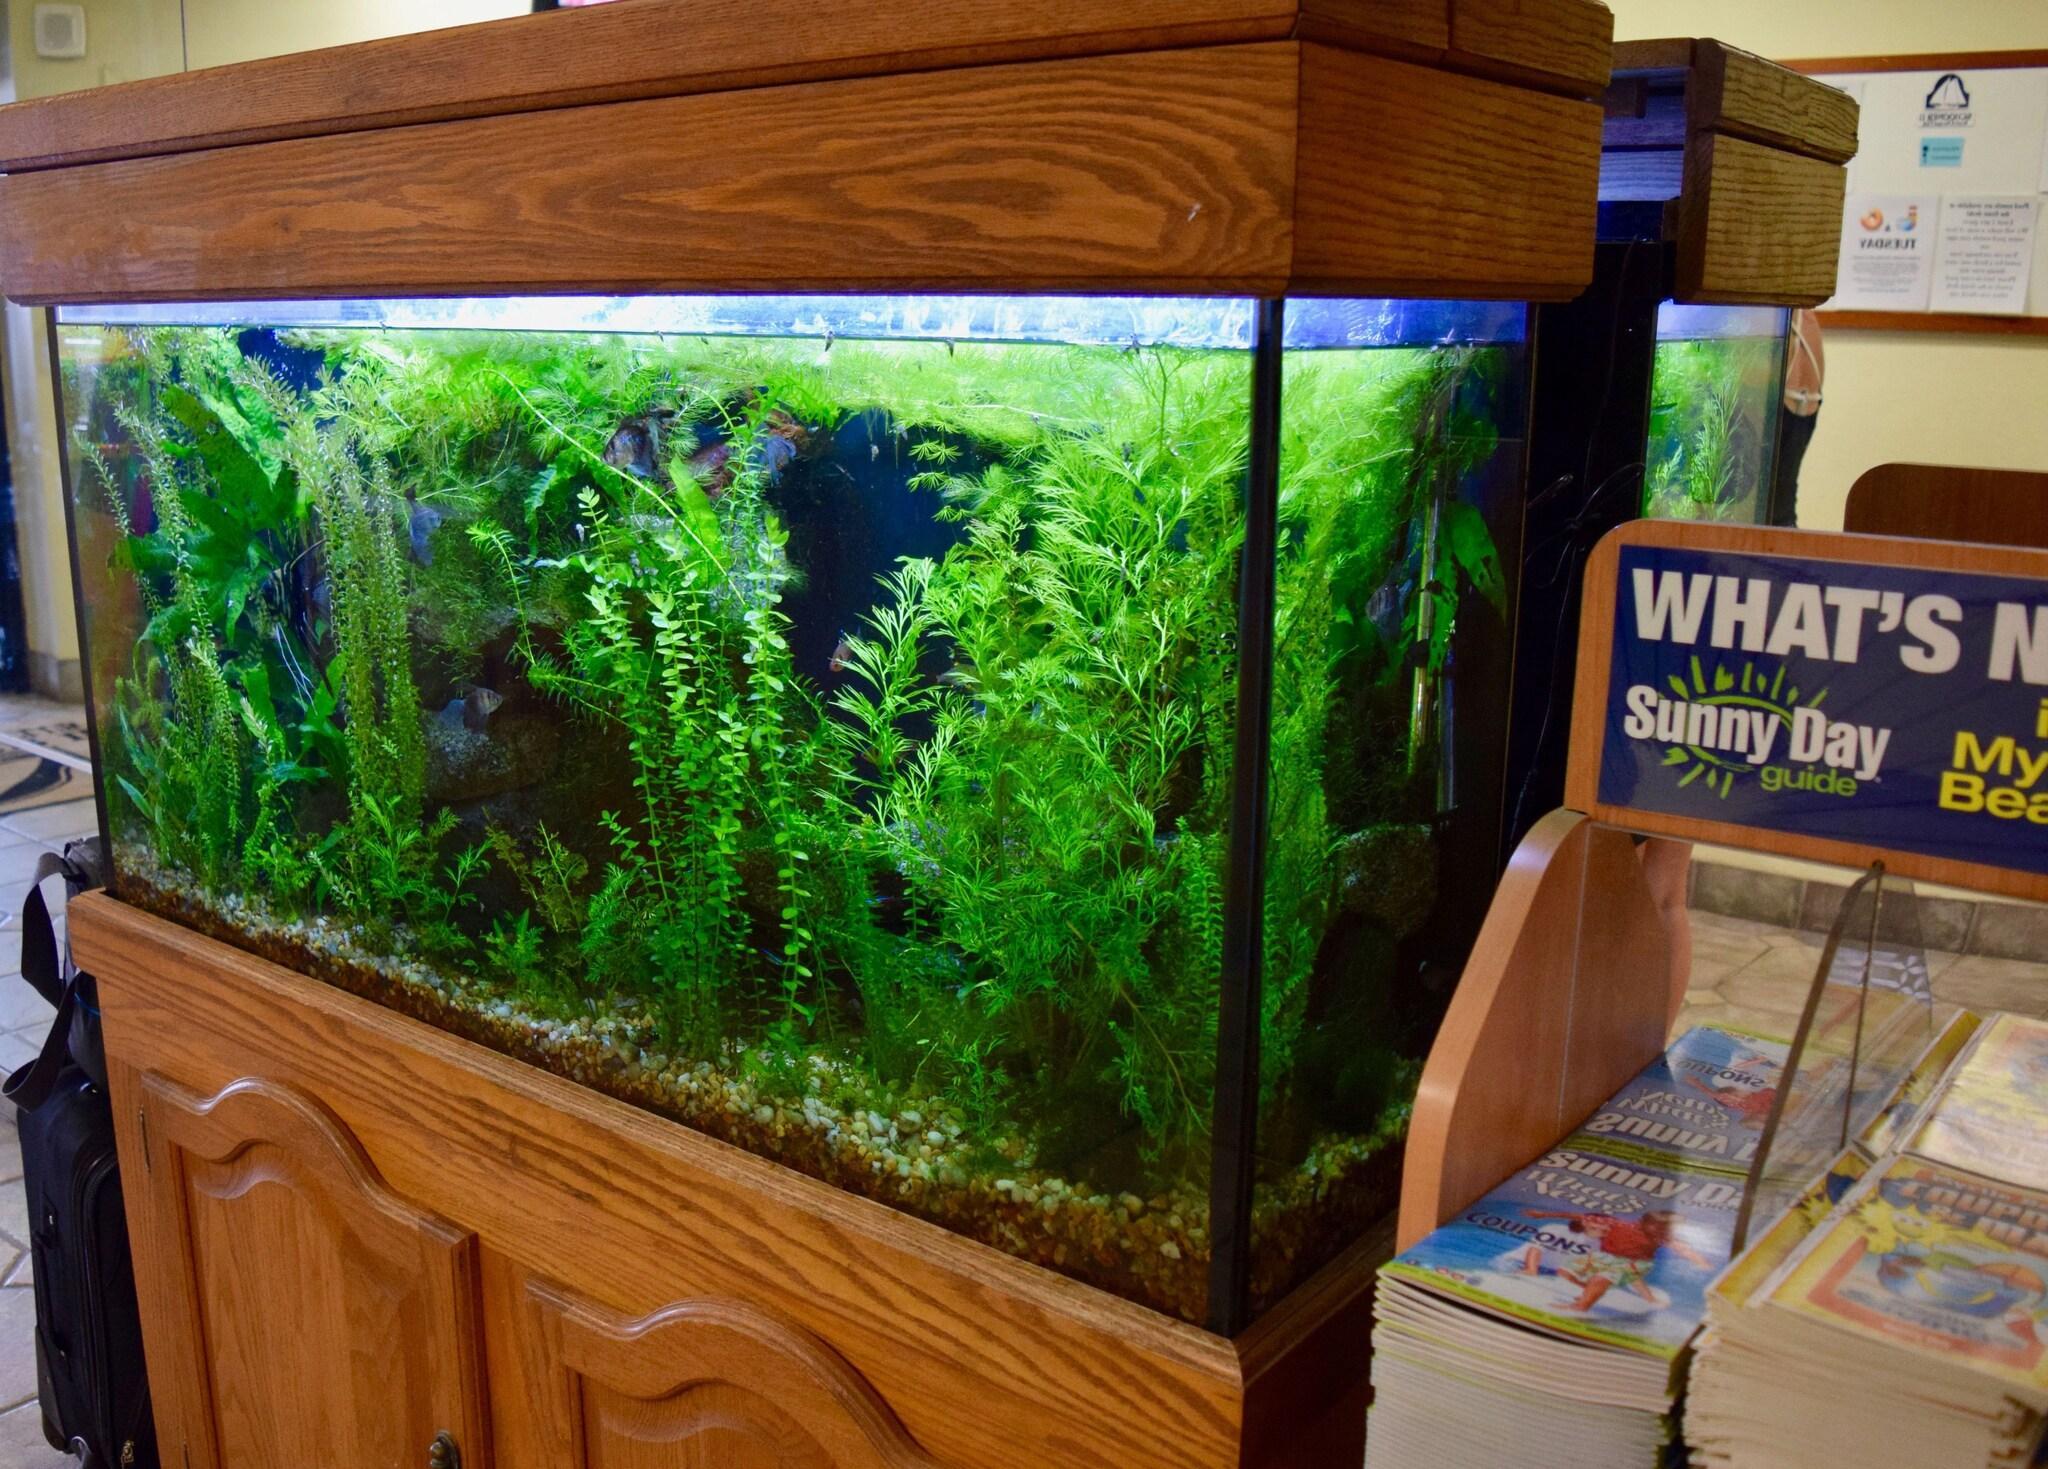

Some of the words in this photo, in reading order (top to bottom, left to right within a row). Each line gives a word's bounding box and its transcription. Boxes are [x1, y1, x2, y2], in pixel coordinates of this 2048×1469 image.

[1632, 567, 1963, 674] WHAT'S
[1624, 684, 1781, 764] Sunny
[1789, 706, 1891, 781] Day
[1952, 731, 2048, 788] My
[1761, 766, 1857, 797] guide
[1537, 1149, 1691, 1200] Sunny
[1466, 1212, 1592, 1255] COUPONS
